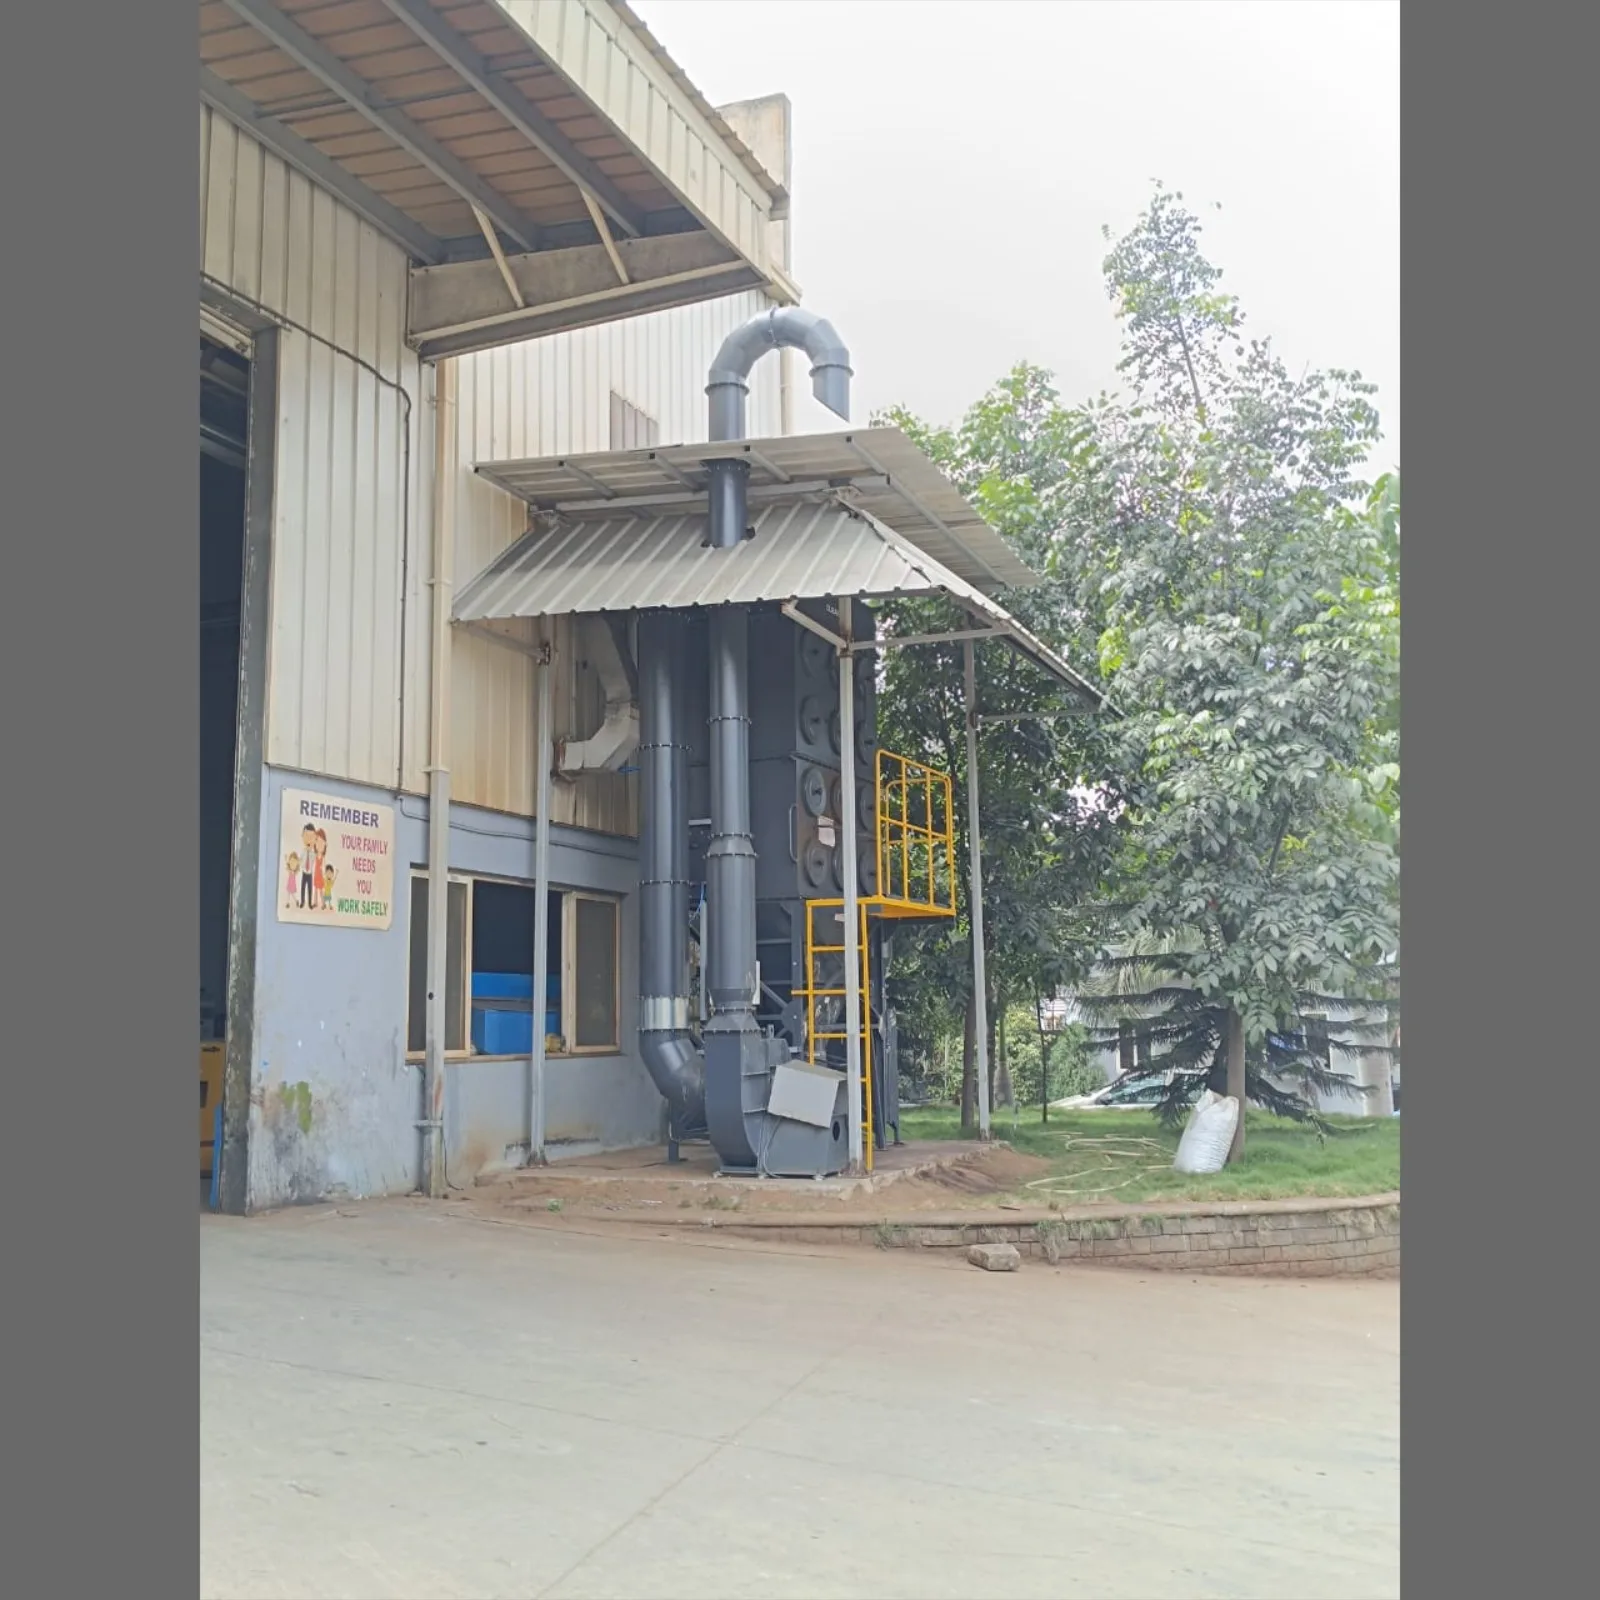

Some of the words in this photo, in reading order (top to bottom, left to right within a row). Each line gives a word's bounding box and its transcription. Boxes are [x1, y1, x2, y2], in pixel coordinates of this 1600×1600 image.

[300, 800, 379, 828] REMEMBER
[341, 834, 361, 851] YOUR
[363, 838, 388, 855] FAMILY
[352, 857, 376, 874] NEEDS
[357, 880, 372, 895] YOU
[338, 898, 359, 914] WORK
[361, 900, 388, 916] SAFELY
